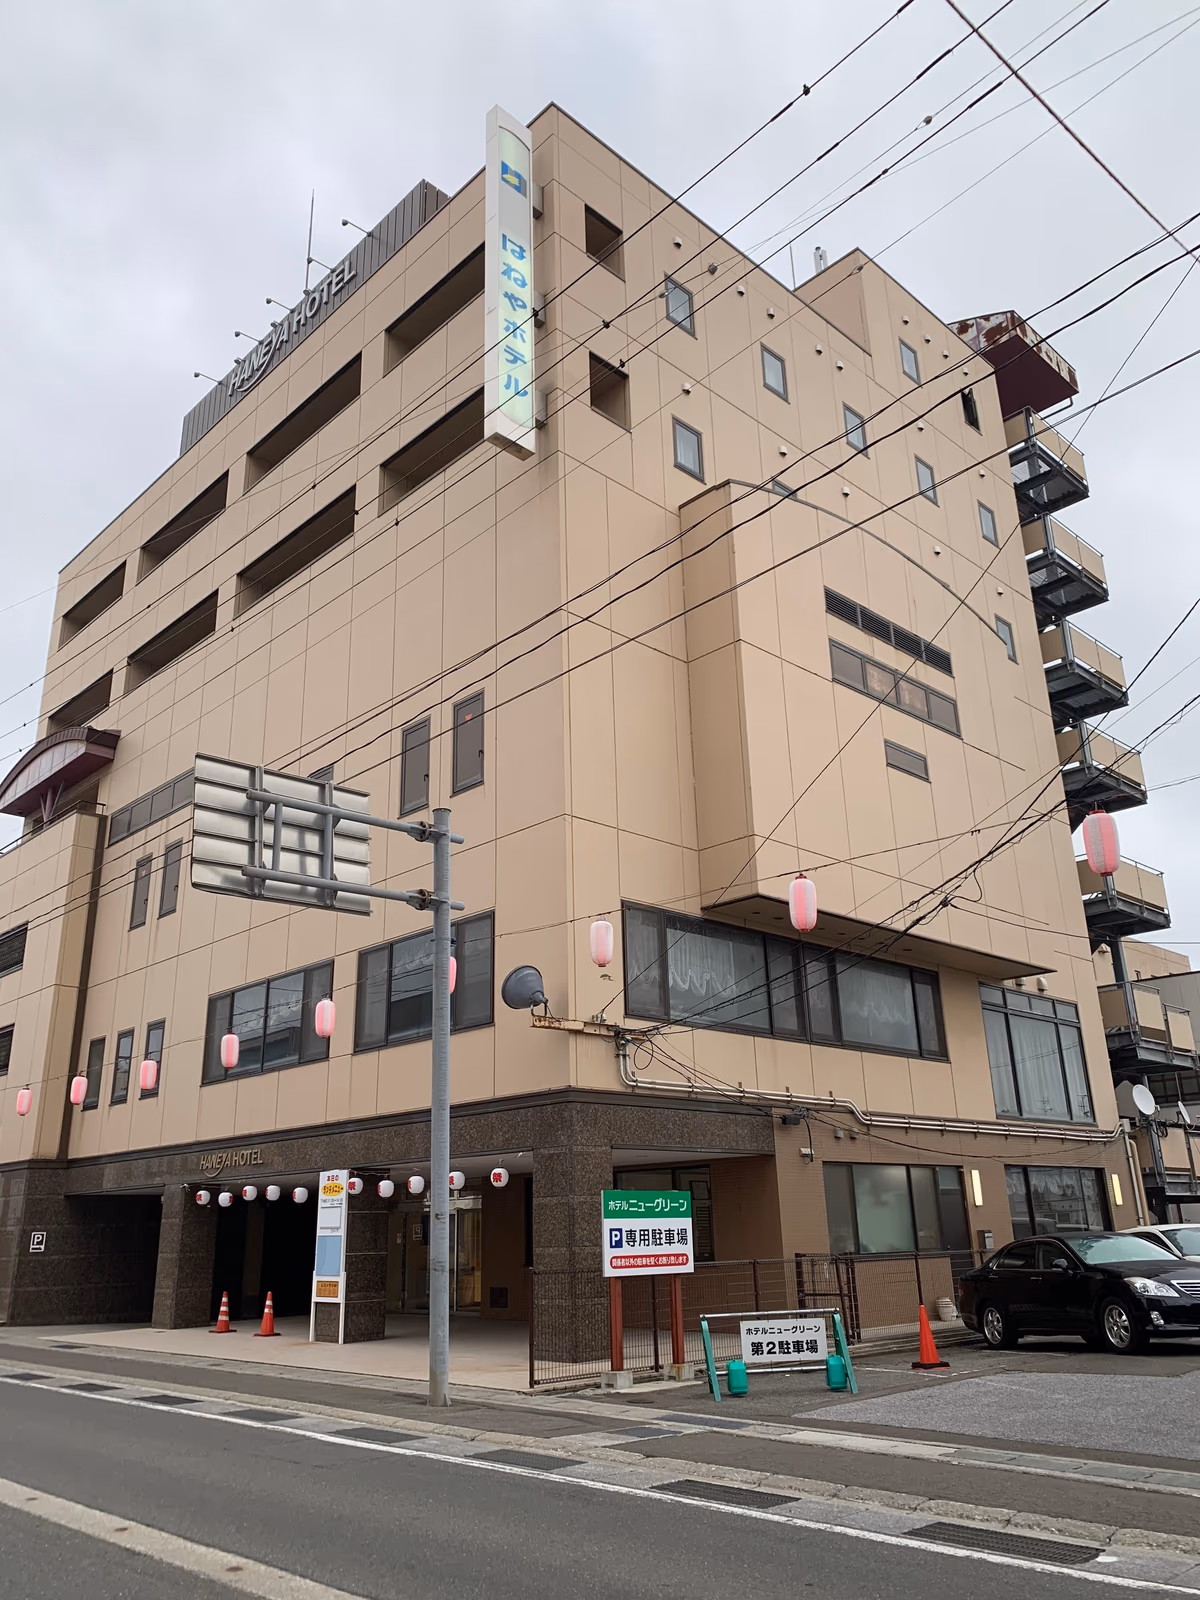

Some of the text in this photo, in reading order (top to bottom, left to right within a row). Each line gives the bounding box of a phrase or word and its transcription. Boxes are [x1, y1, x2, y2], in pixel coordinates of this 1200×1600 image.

[501, 233, 529, 398] はねやホテル
[228, 261, 356, 398] HANEYA HOTEL
[199, 1149, 263, 1177] HANEYA HOTEL
[493, 1172, 502, 1182] 祭
[608, 1198, 687, 1212] ホテルニューグリーン
[624, 1228, 689, 1247] 専用駐車場
[745, 1324, 821, 1336] ホテルニューグリーン
[750, 1338, 818, 1356] 第2駐車場
